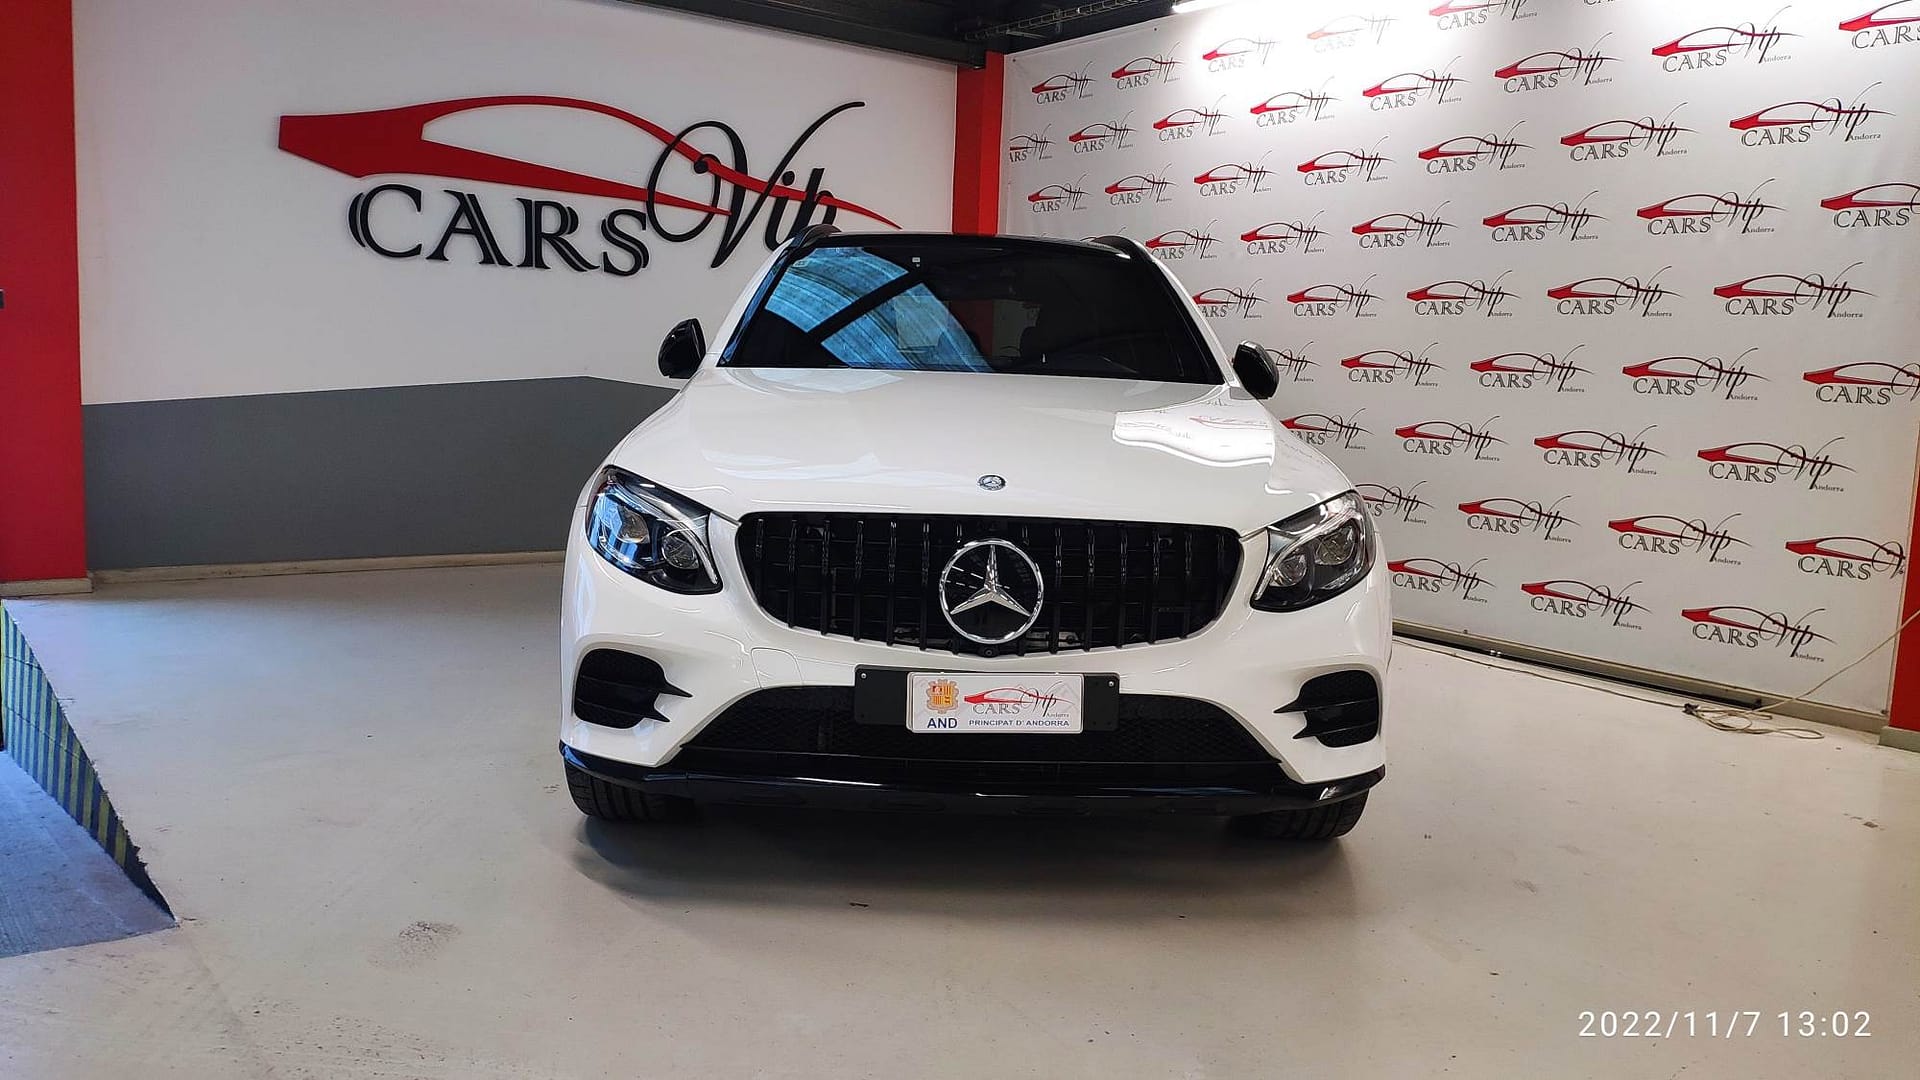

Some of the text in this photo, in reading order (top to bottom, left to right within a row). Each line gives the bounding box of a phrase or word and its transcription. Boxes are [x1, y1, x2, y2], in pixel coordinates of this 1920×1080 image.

[1437, 9, 1489, 31] CARS
[1662, 5, 1793, 73] CARS Vip
[1504, 31, 1614, 94] CARS Vip
[1761, 53, 1792, 63] Andorra
[1036, 89, 1067, 105] CARS
[1116, 74, 1150, 90] CARS
[1370, 55, 1462, 112] CARS Vip
[1256, 110, 1297, 128] CARS
[1741, 81, 1882, 147] CARS Vip
[1074, 140, 1105, 154] CARS
[1158, 126, 1194, 142] CARS
[1426, 120, 1526, 174] CARS Vip
[1569, 102, 1688, 162] CARS Vip
[1847, 132, 1882, 141] Andorra
[1304, 135, 1389, 186] CARS Vip
[1659, 148, 1688, 156] Andorra
[348, 101, 865, 278] CARS Vip
[1110, 192, 1142, 206] CARS
[1200, 181, 1237, 197] CARS
[1032, 200, 1061, 213] CARS
[1491, 190, 1599, 243] CARS Vip
[1647, 178, 1776, 235] CARS Vip
[1833, 207, 1911, 228] CARS
[1359, 200, 1451, 249] CARS Vip
[1745, 226, 1775, 234] Andorra
[1151, 247, 1185, 260] CARS
[1246, 240, 1286, 256] CARS
[1414, 269, 1513, 318] CARS Vip
[1556, 265, 1672, 317] CARS Vip
[1725, 261, 1864, 318] CARS Vip
[1199, 305, 1227, 318] ARS
[1294, 302, 1336, 317] CARS
[1348, 342, 1439, 387] CARS Vip
[1479, 344, 1585, 393] CARS Vip
[1633, 347, 1759, 400] CARS Vip
[1728, 393, 1758, 401] Andorra
[1815, 385, 1891, 405] CARS
[1325, 407, 1367, 449] Vip
[1403, 415, 1501, 460] CARS Vip
[1543, 424, 1658, 473] CARS Vip
[1708, 436, 1845, 490] CARS Vip
[1629, 466, 1657, 476] Andorra
[1382, 480, 1427, 522] Vip
[1811, 483, 1844, 493] Andorra
[1467, 495, 1572, 542] CARS Vip
[1618, 512, 1742, 562] CARS Vip
[1710, 555, 1742, 566] Andorra
[1797, 556, 1871, 581] CARS
[1392, 558, 1489, 600] CARS Vip
[1530, 580, 1643, 627] CARS Vip
[1614, 620, 1643, 631] Andorra
[1692, 608, 1826, 658] CARS Vip
[1791, 652, 1825, 663] Andorra
[972, 680, 1063, 717] CARS Vip
[927, 718, 958, 729] AND
[968, 719, 1014, 727] PRINCIPAT
